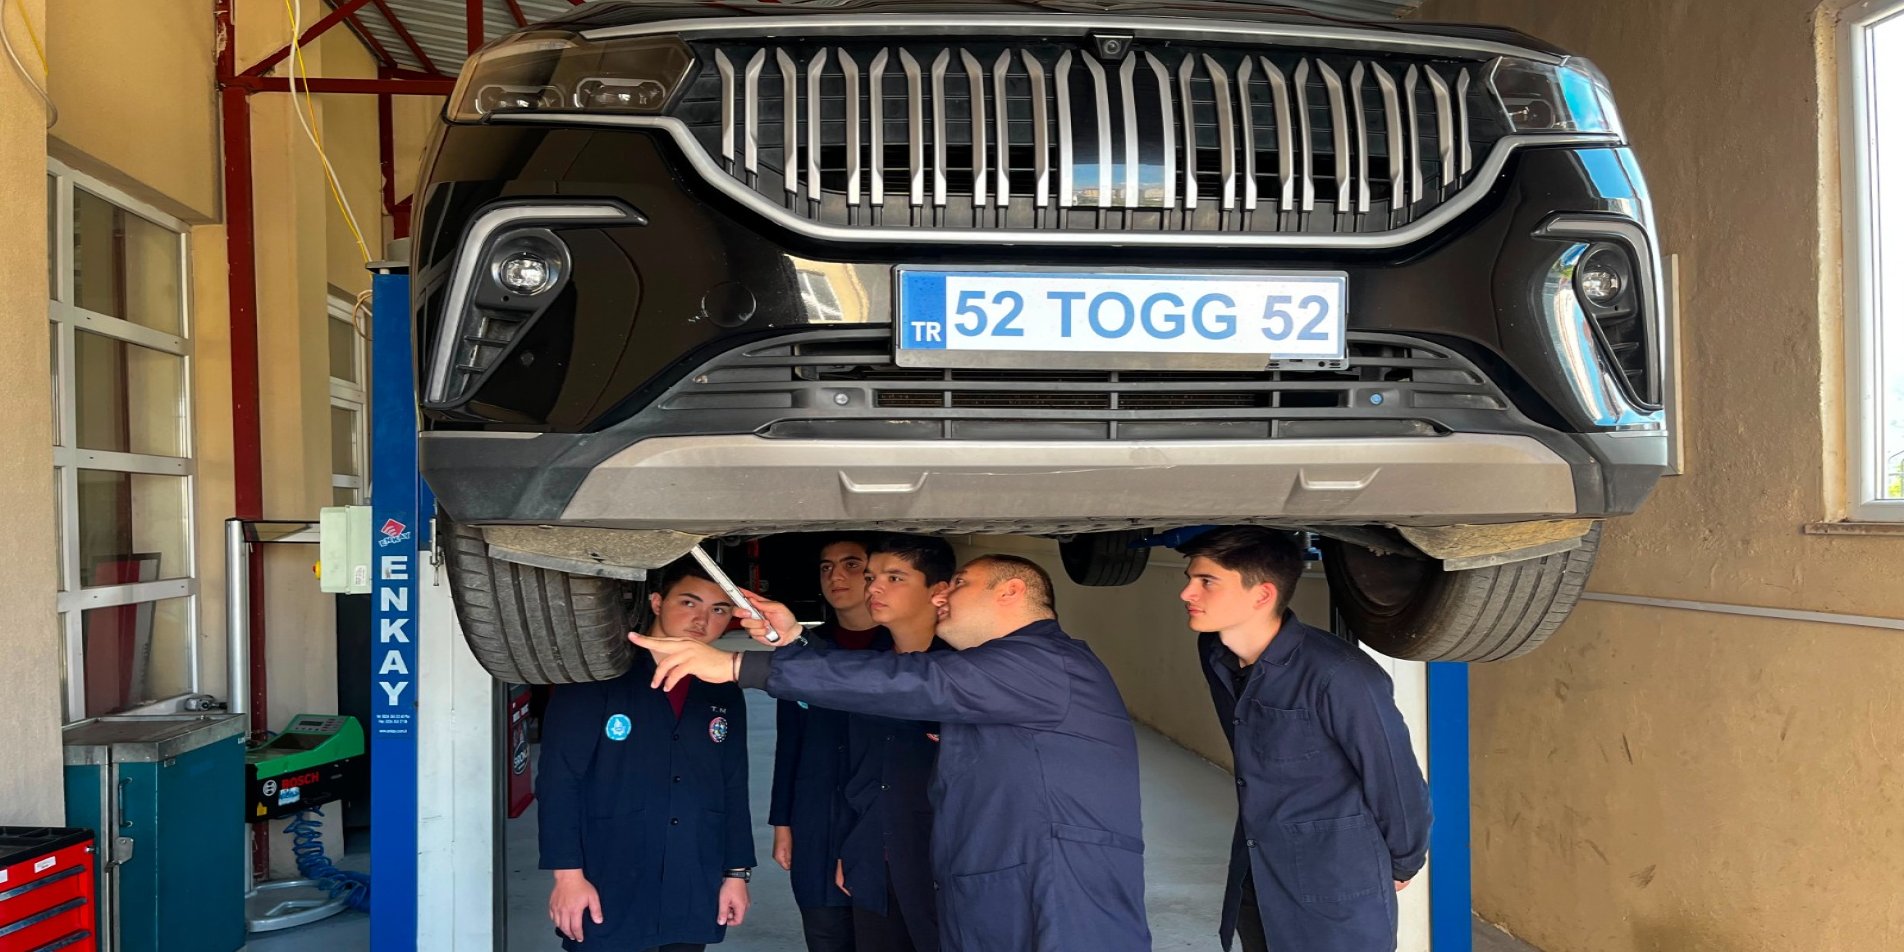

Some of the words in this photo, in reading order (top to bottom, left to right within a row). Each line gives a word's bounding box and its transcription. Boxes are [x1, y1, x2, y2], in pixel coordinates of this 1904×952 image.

[911, 321, 941, 342] TR
[954, 290, 1025, 337] 52
[1047, 290, 1237, 341] TOGG
[1262, 294, 1329, 341] 52
[379, 555, 410, 706] ENKAY
[281, 773, 319, 789] BOSCH
